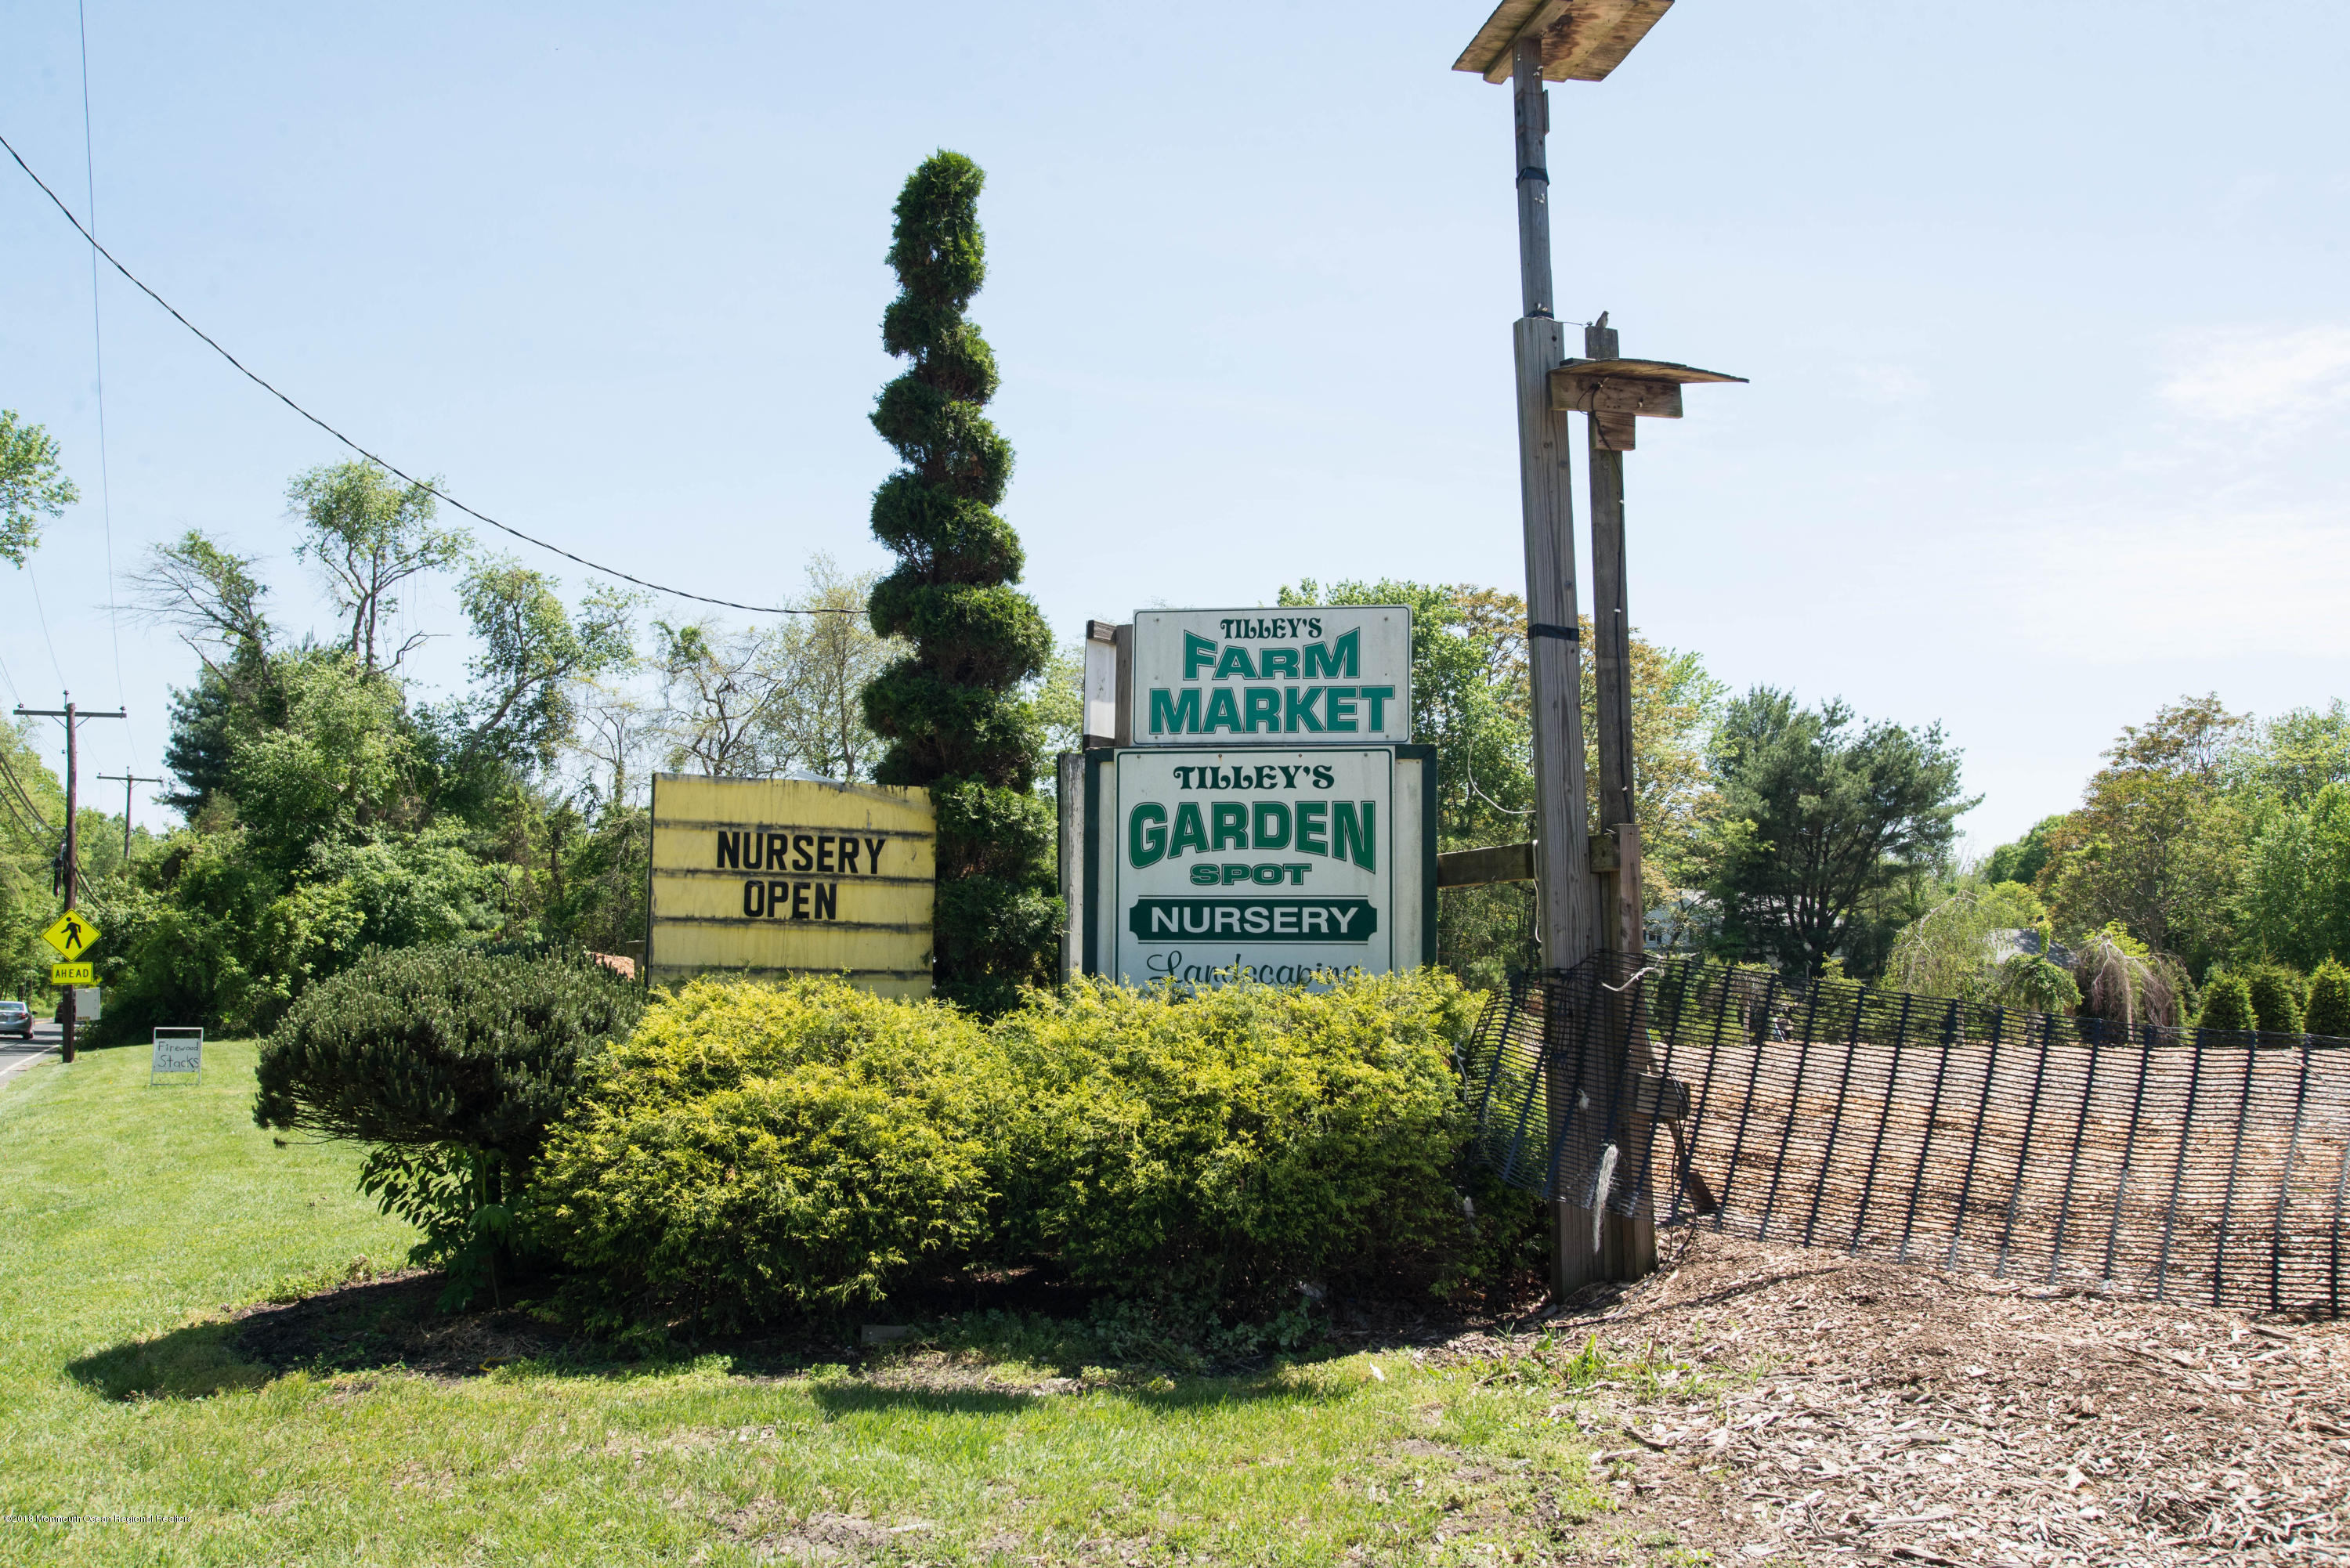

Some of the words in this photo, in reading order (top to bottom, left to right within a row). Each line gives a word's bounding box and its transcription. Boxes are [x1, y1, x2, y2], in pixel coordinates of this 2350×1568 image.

[1220, 618, 1322, 639] TILLEY'S
[1183, 627, 1360, 681] FARM
[1149, 685, 1395, 735] MARKET
[1173, 765, 1335, 789] TILLEY'S
[1128, 800, 1376, 875] GARDEN
[717, 831, 886, 875] NURSERY
[1190, 863, 1312, 886] SPOT
[743, 880, 837, 920] OPEN
[1152, 906, 1359, 934] NURSERY
[55, 968, 90, 978] AHEAD
[157, 1041, 199, 1052] Firewood
[157, 1054, 201, 1068] Stacks
